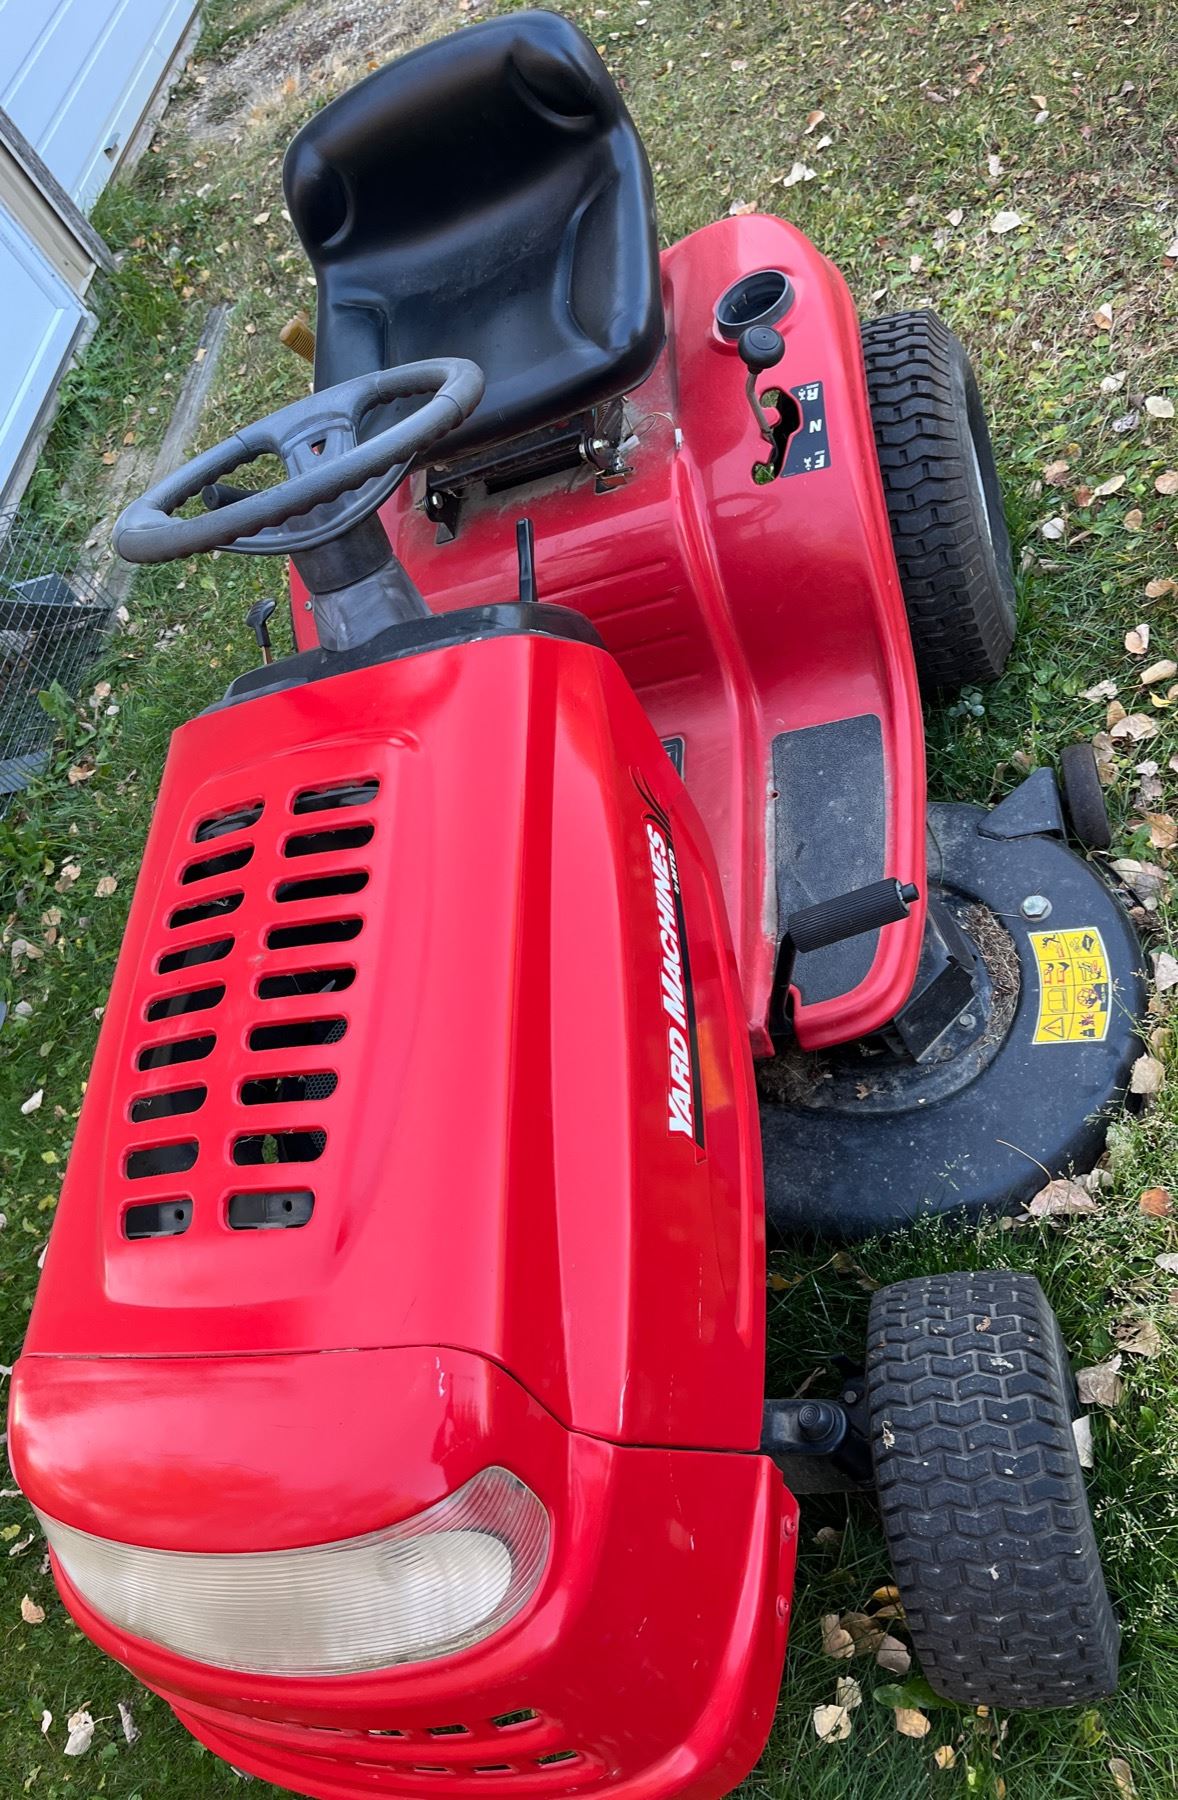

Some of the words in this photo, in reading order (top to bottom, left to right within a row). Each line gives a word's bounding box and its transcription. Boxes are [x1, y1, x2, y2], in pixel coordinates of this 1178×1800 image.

[807, 388, 819, 401] R
[809, 419, 822, 433] N
[814, 455, 825, 468] F
[668, 848, 678, 883] MTD
[647, 824, 686, 1029] MACHINES
[668, 1026, 693, 1138] YARD
